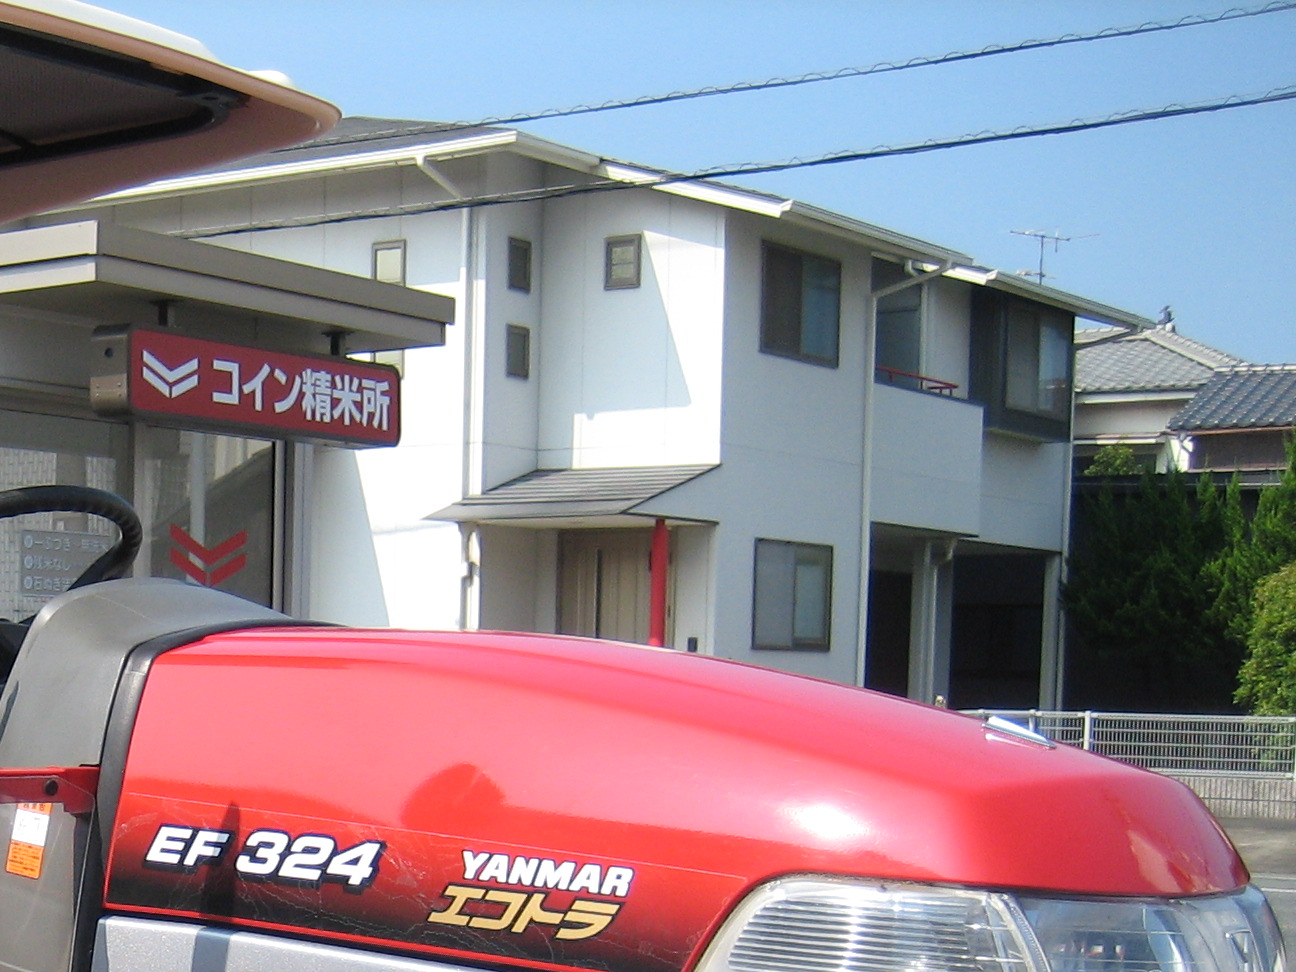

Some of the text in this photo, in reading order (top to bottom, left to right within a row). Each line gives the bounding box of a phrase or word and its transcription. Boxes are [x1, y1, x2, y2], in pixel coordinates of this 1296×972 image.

[211, 358, 392, 431] コイン精米所
[145, 825, 382, 886] EF 324
[461, 850, 634, 898] YANMAR
[426, 884, 622, 941] エコトラ
